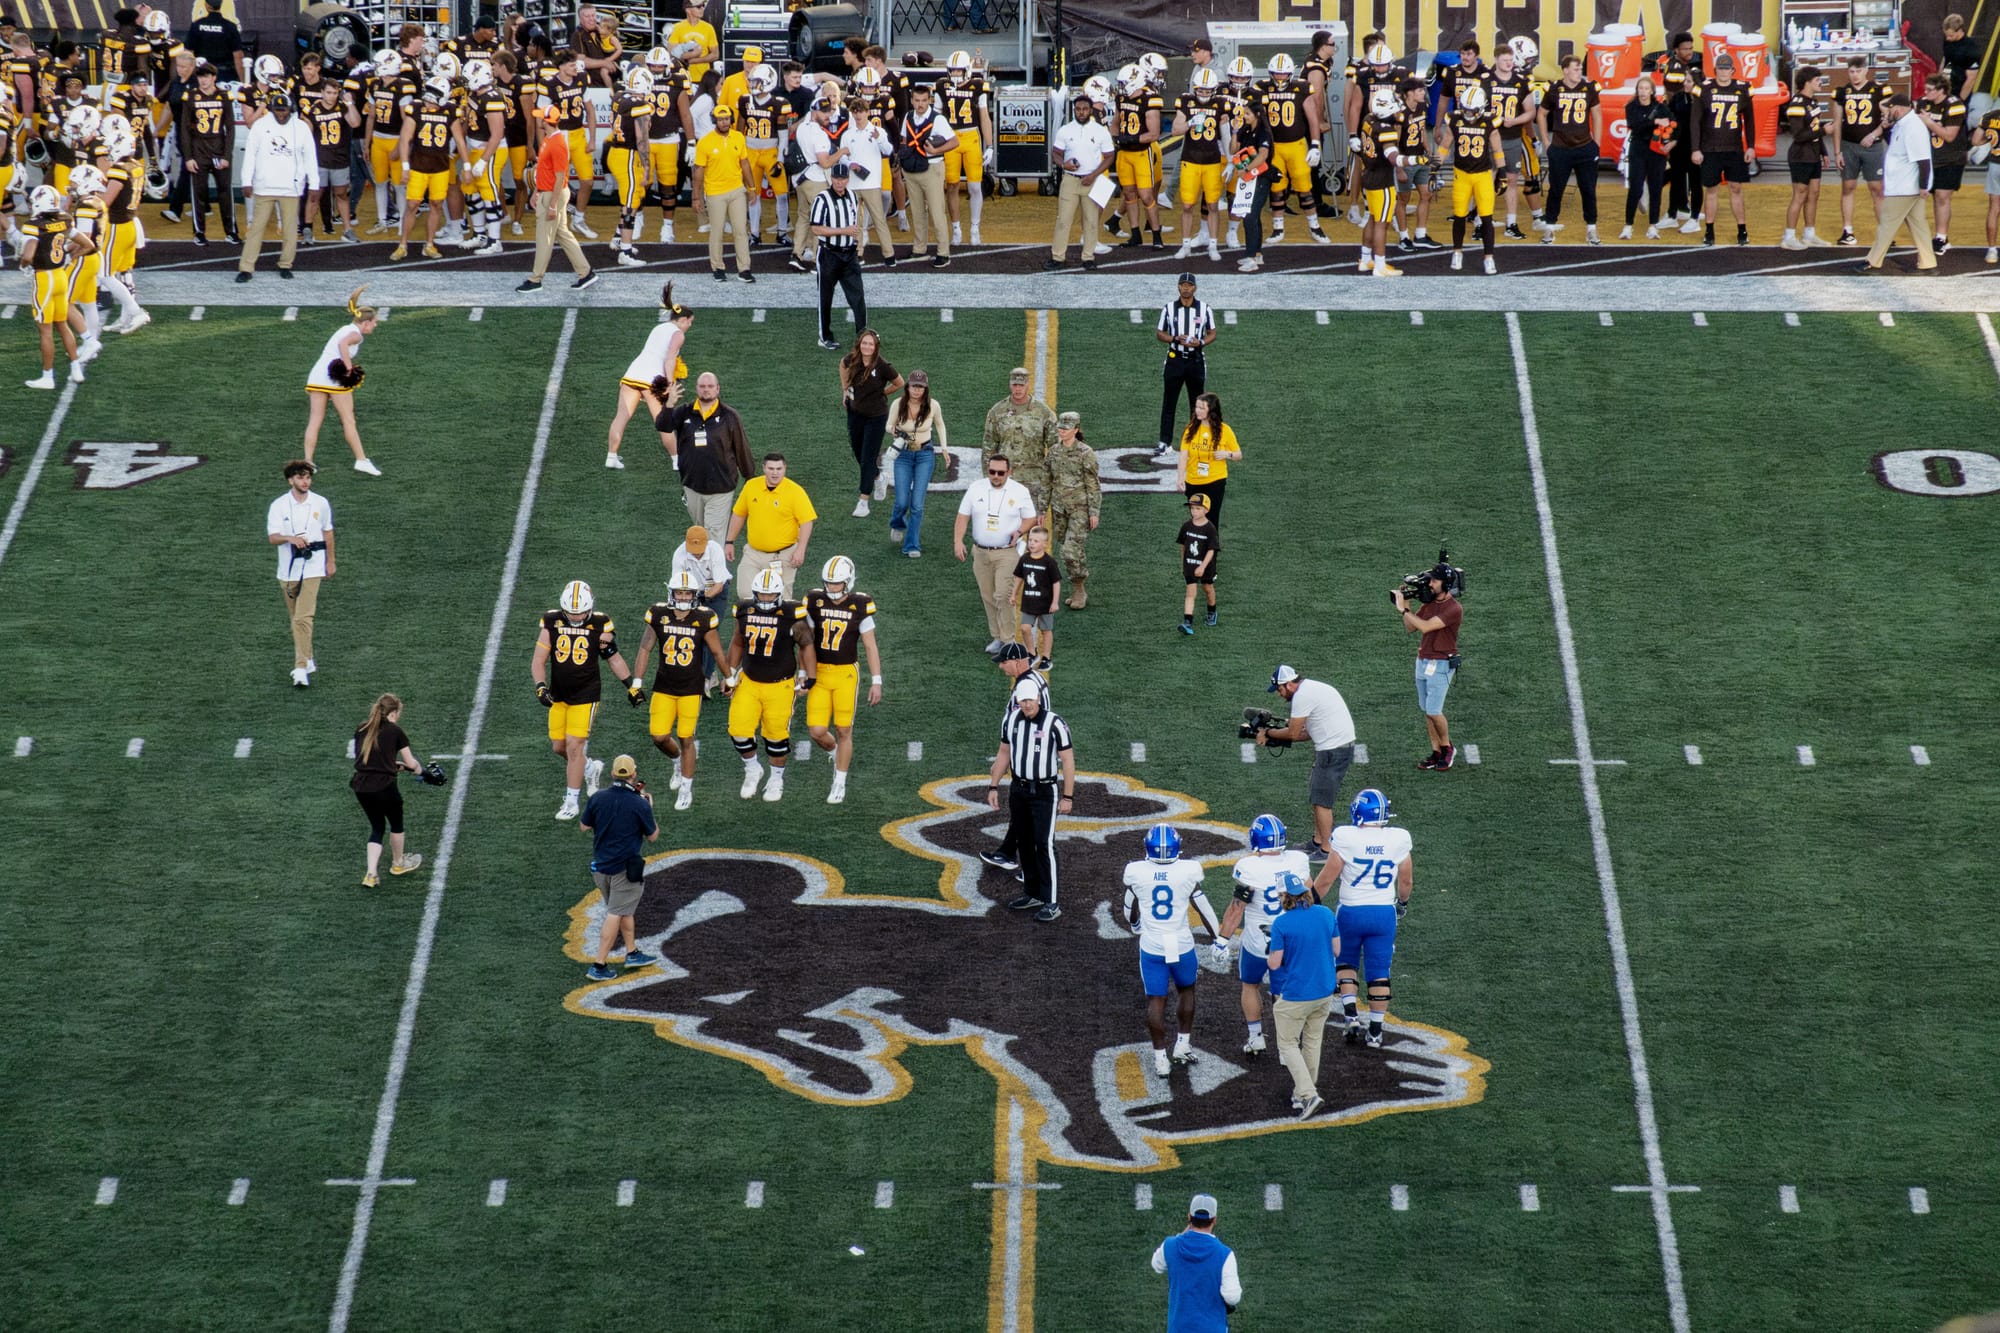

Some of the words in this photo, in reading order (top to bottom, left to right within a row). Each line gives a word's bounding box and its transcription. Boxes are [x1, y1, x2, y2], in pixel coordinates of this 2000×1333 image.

[199, 24, 223, 32] POLICE
[1601, 53, 1614, 66] G
[1744, 54, 1757, 66] G
[195, 108, 223, 134] 37
[560, 96, 583, 120] 13
[947, 97, 974, 124] 14
[1003, 105, 1042, 117] Union
[1268, 100, 1296, 127] 60
[1559, 99, 1588, 124] 78
[1711, 102, 1738, 129] 74
[1845, 99, 1873, 125] 62
[319, 120, 341, 145] 19
[418, 122, 448, 148] 49
[1609, 119, 1628, 138] G
[1458, 134, 1485, 158] 33
[745, 625, 778, 657] 77
[821, 618, 848, 651] 17
[555, 634, 589, 666] 96
[662, 635, 695, 667] 43
[1365, 845, 1385, 855] MOORE
[1350, 857, 1395, 889] 76
[1151, 885, 1173, 920] 8
